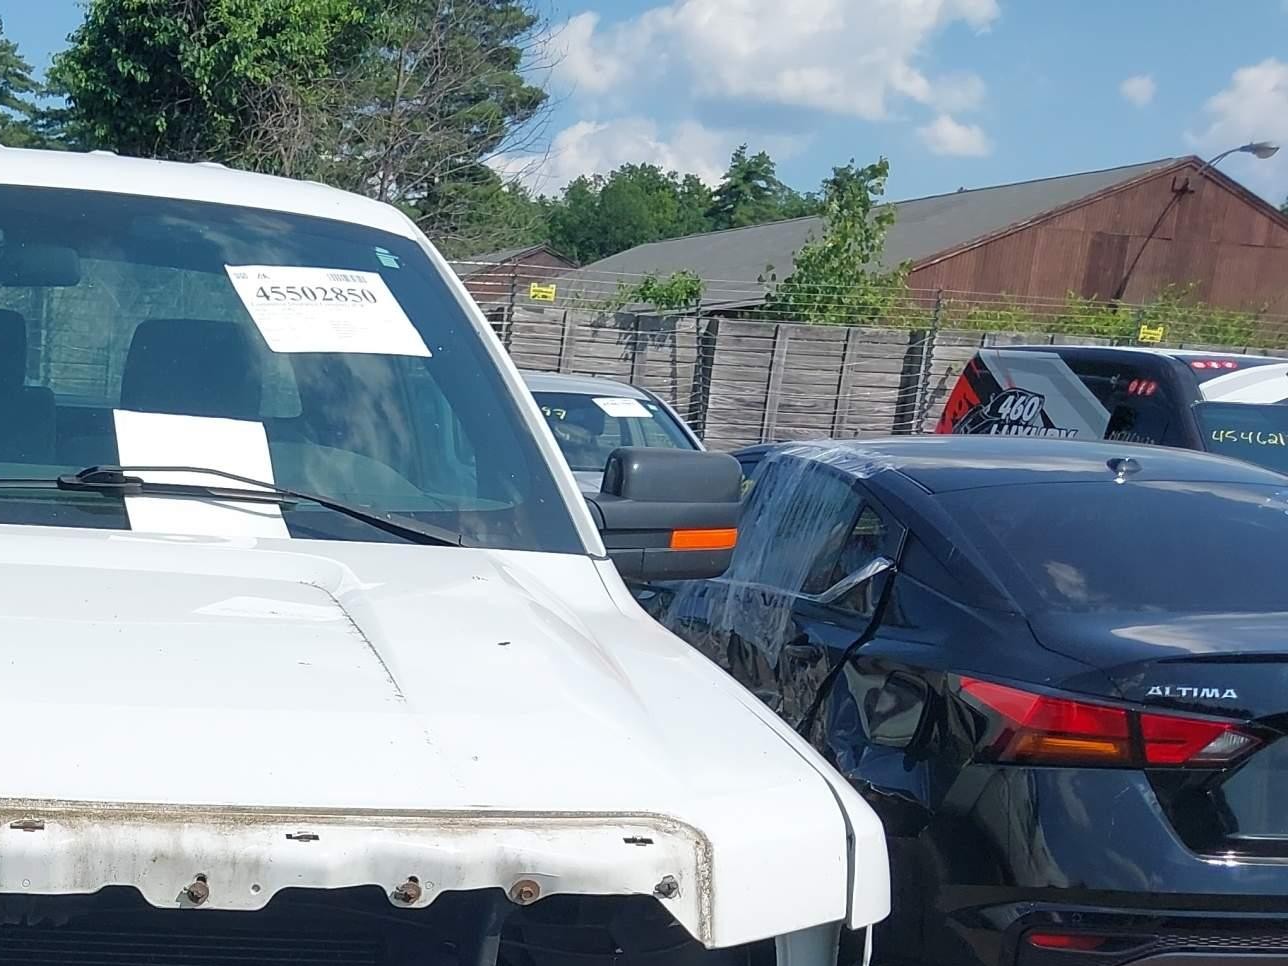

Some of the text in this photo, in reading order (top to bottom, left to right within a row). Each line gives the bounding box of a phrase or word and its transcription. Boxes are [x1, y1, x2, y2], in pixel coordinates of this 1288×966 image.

[256, 286, 377, 304] 45502850
[998, 394, 1040, 423] 460
[1212, 430, 1288, 446] 454621
[1145, 686, 1238, 698] ALTIMA
